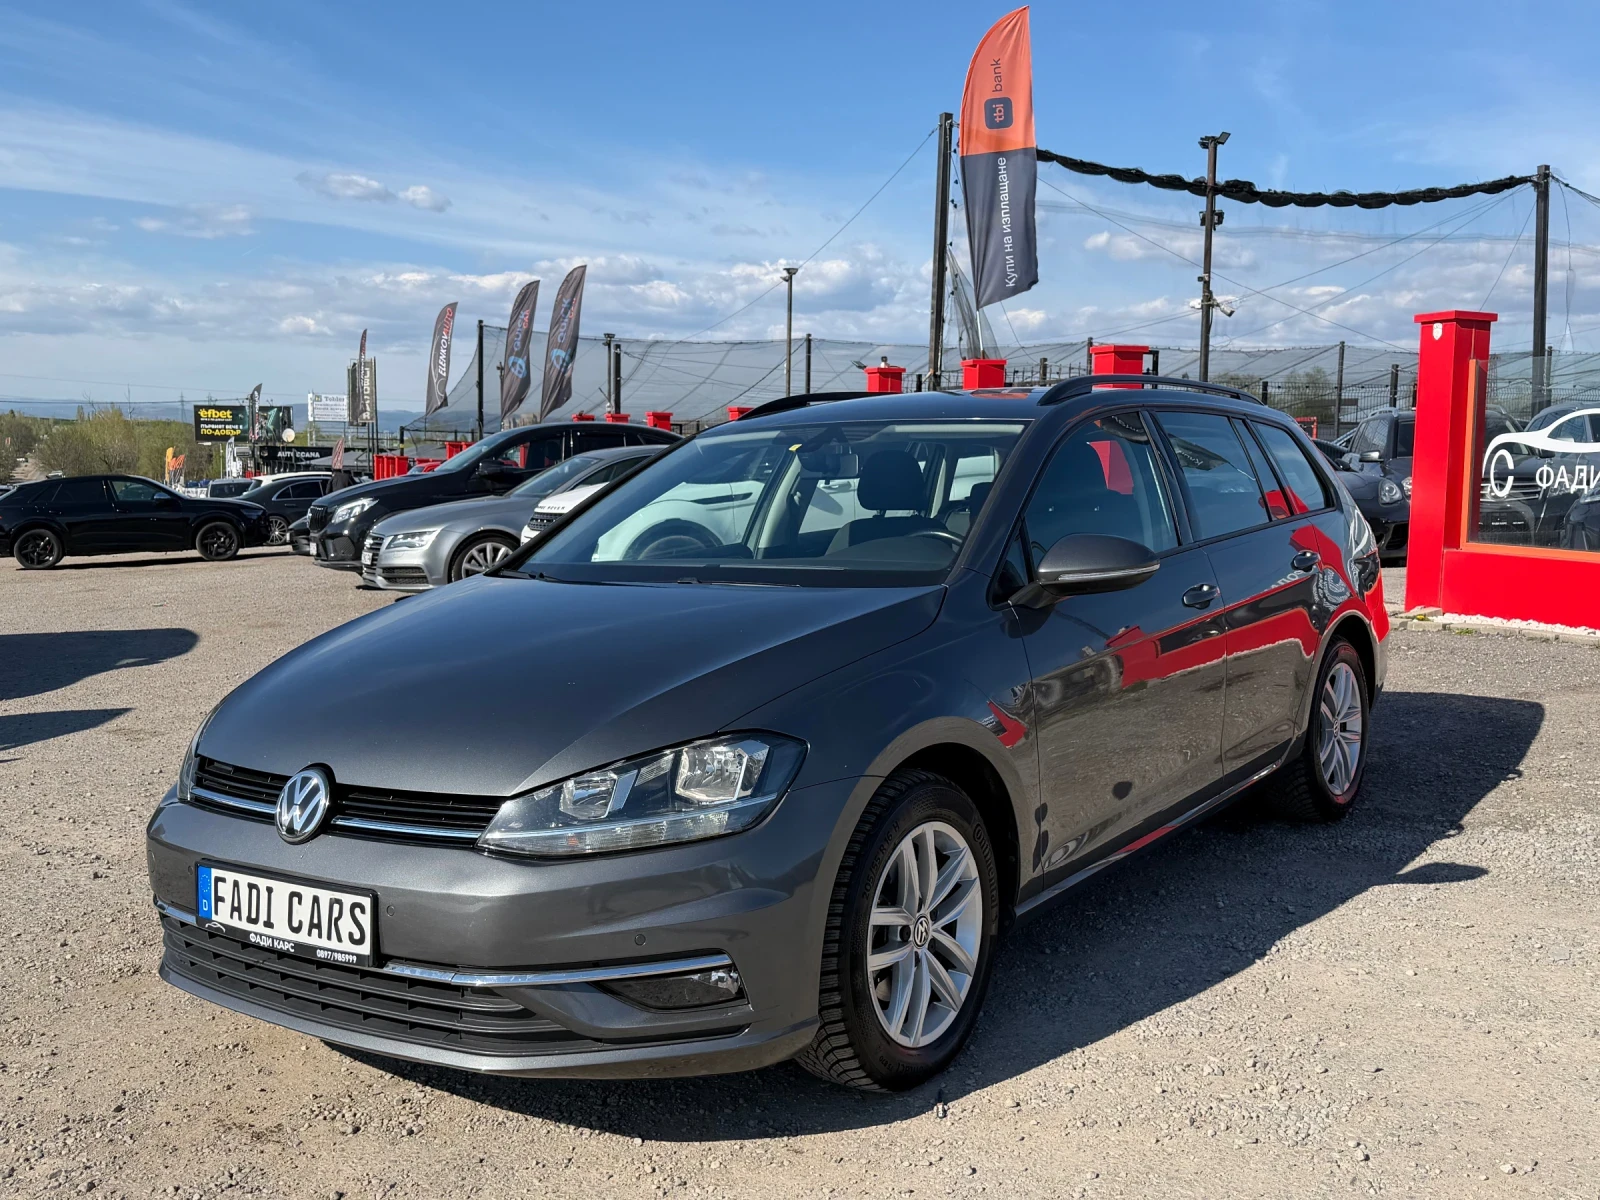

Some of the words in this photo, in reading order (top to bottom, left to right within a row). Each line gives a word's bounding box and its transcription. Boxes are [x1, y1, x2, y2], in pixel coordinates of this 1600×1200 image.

[990, 58, 1003, 93] bank
[992, 103, 1004, 123] tbi
[997, 157, 1013, 233] изплащане
[1003, 235, 1013, 252] на
[1005, 255, 1018, 287] Купи
[199, 408, 233, 418] efbet
[200, 428, 241, 436] ПО-ДОБЪР
[862, 855, 880, 900] 205/55
[879, 844, 887, 854] R
[885, 831, 893, 845] 16
[892, 821, 900, 832] H
[202, 899, 208, 911] D
[213, 875, 275, 929] FADI
[287, 890, 366, 946] CARS
[249, 932, 273, 947] ФАДИ
[273, 938, 295, 952] КАРС
[316, 949, 357, 963] 0897/985999
